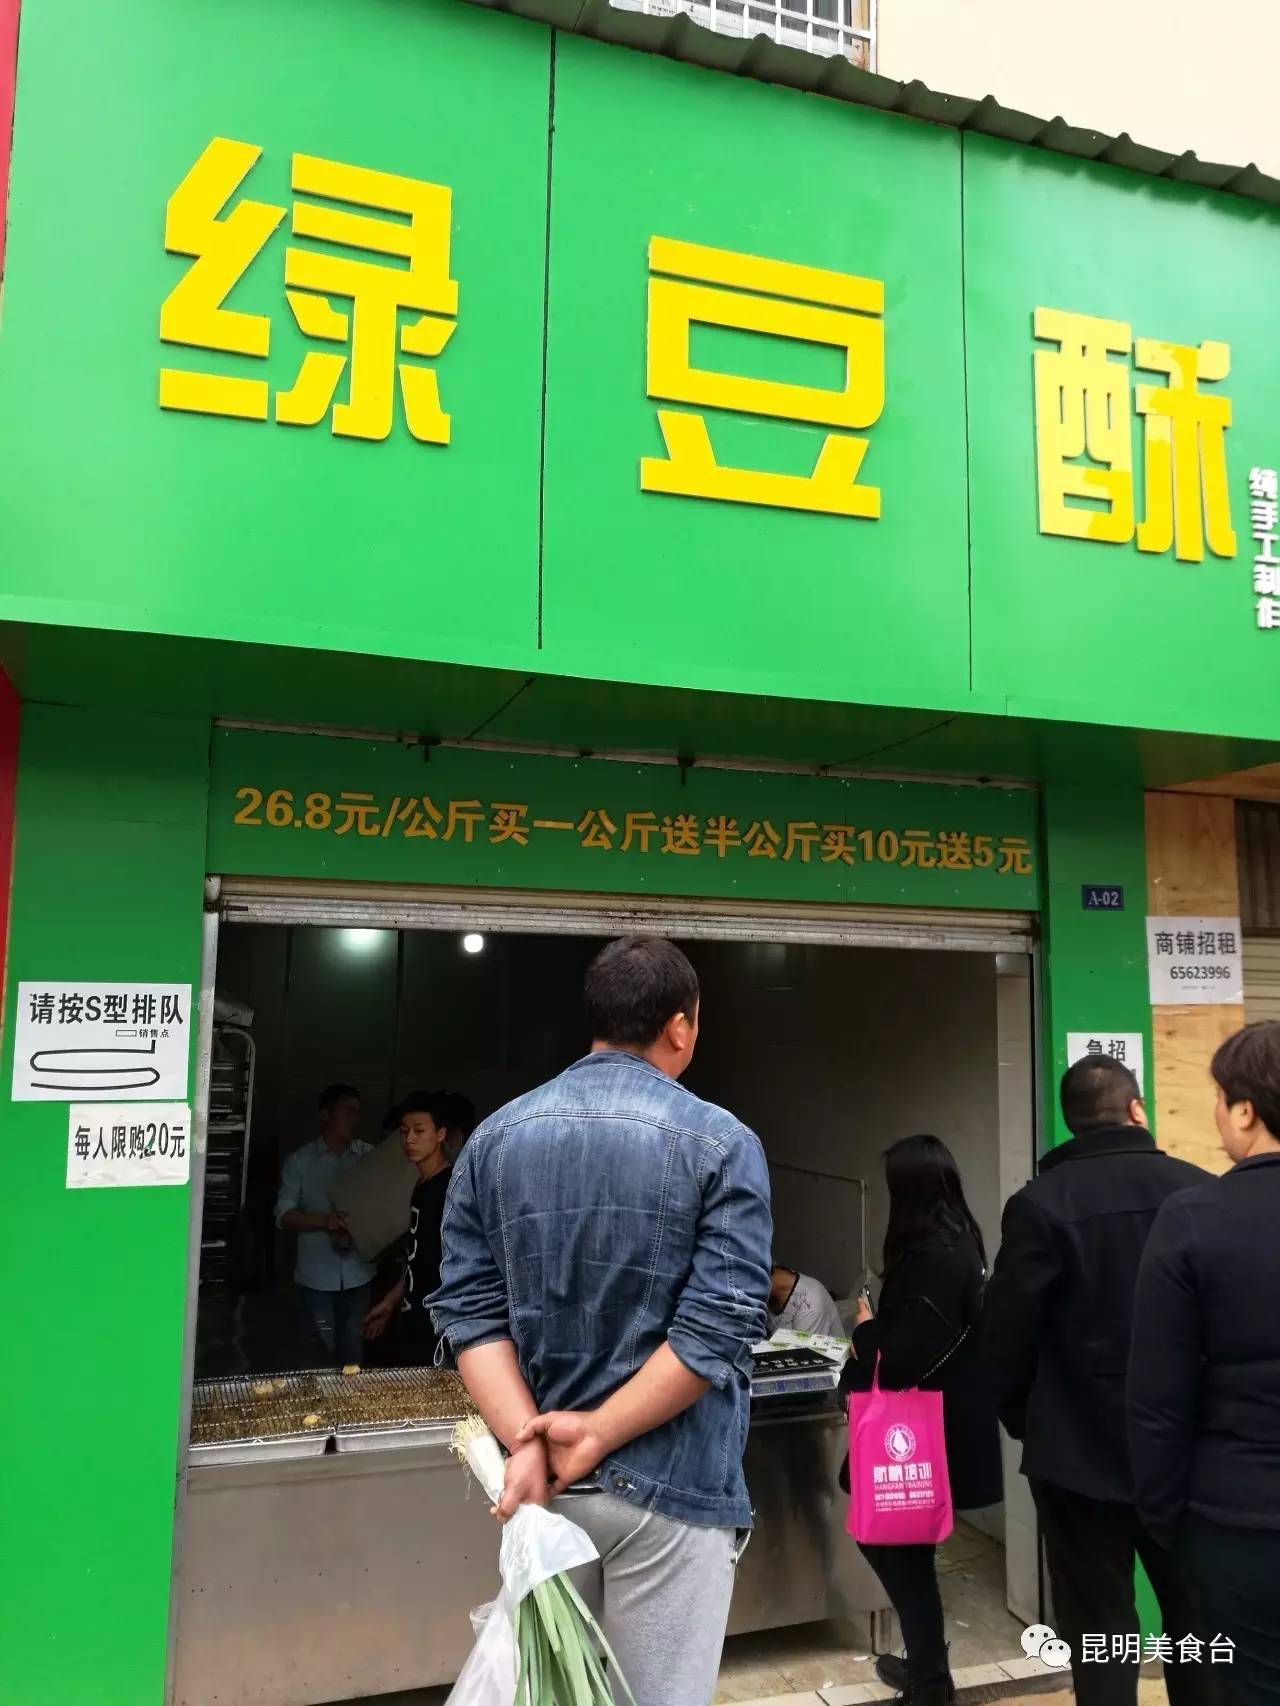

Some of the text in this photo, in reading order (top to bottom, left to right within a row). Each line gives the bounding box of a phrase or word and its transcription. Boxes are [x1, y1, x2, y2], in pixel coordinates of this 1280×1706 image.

[160, 136, 1239, 563] 绿豆酥
[234, 786, 1033, 875] 26.8元/公斤买一公斤送半公斤买10元送5元
[1087, 891, 1120, 906] A-02
[1155, 931, 1237, 956] 商铺招租
[1170, 966, 1231, 980] 65623996
[29, 992, 184, 1025] 请按S型排队
[139, 1028, 170, 1038] 销售点
[74, 1122, 186, 1161] 每人限购20元
